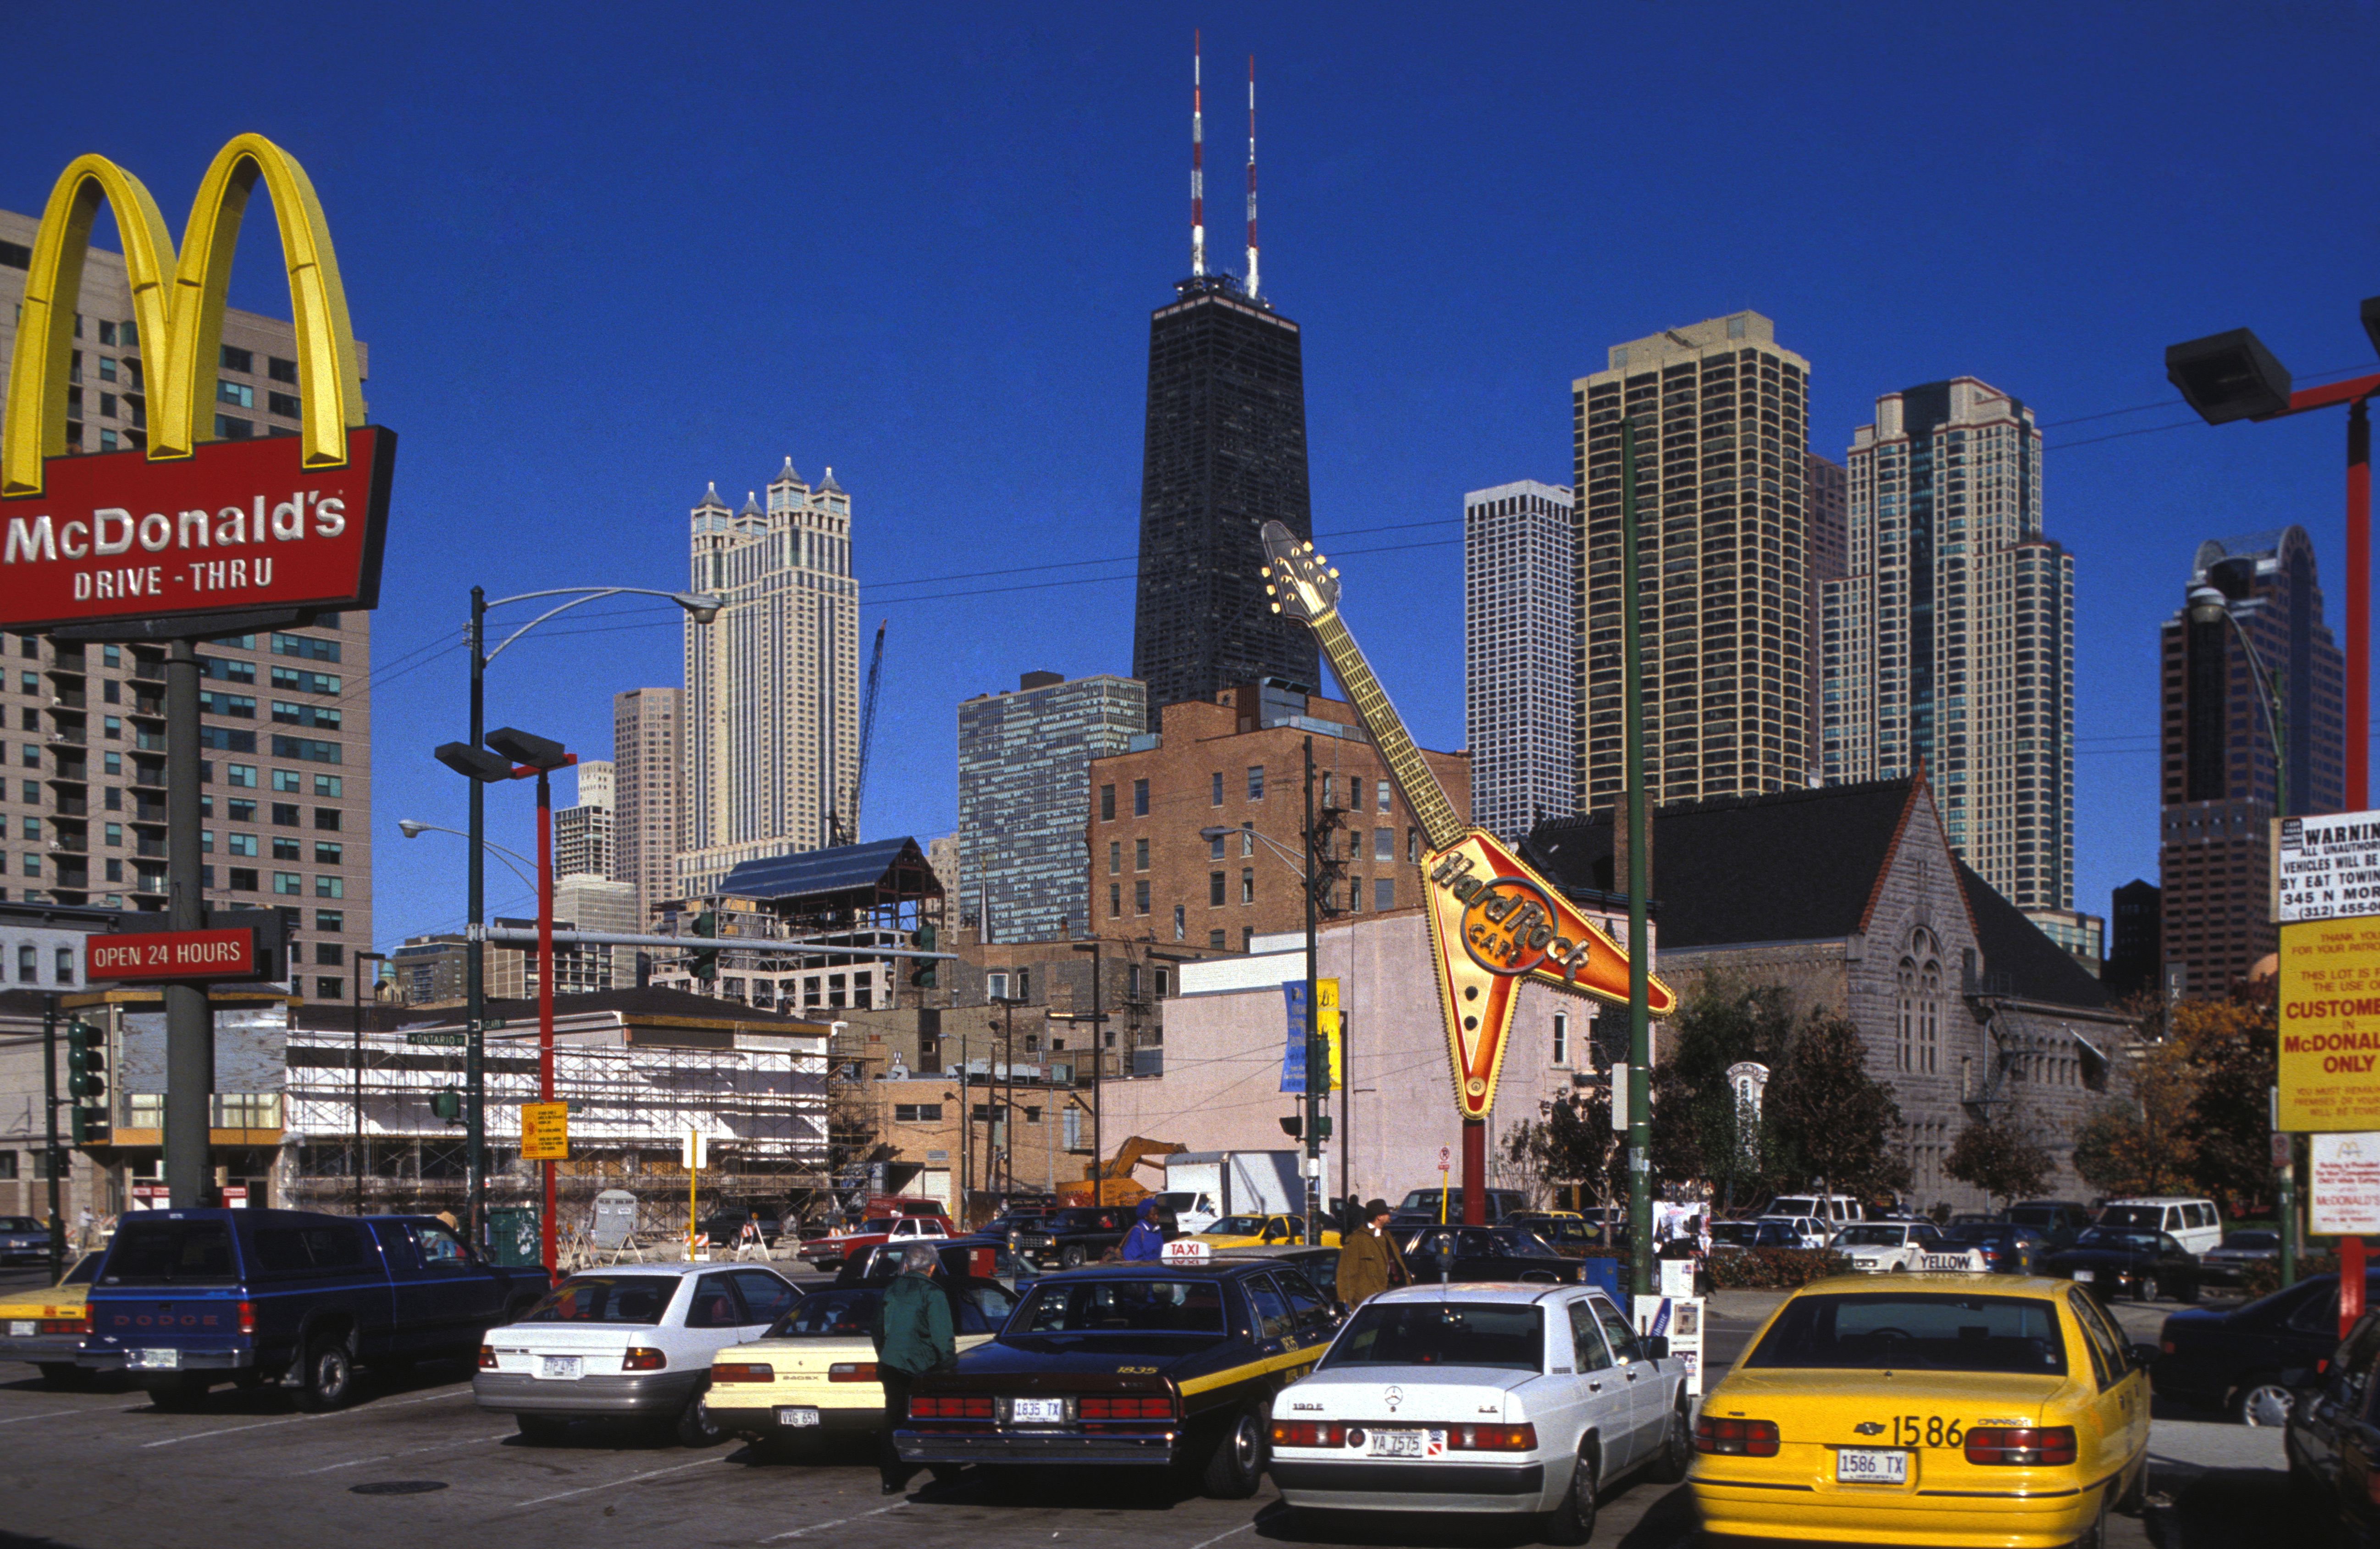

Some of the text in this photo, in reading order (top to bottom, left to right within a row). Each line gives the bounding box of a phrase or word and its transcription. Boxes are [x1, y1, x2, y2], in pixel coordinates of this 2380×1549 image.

[4, 489, 346, 564] McDonald's
[2301, 847, 2318, 857] ALL
[2284, 853, 2378, 873] VEHICLES WILL BE
[2280, 878, 2297, 890] BY
[2305, 874, 2330, 888] E&T
[2284, 891, 2314, 905] 345
[2323, 890, 2334, 902] N
[1430, 850, 1590, 981] Hard Rock
[2299, 905, 2335, 918] (312)
[2320, 932, 2353, 942] THANK
[95, 941, 241, 968] OPEN 24 HOURS
[2292, 946, 2312, 955] FOR
[2318, 944, 2344, 954] YOUR
[2301, 970, 2325, 980] THIS
[2330, 968, 2353, 979] LOT
[2358, 967, 2370, 978] IS
[2314, 982, 2335, 992] THE
[2340, 980, 2363, 991] USE
[2342, 1019, 2355, 1030] IN
[417, 1035, 455, 1045] ONTARIO
[2323, 1055, 2376, 1073] ONLY
[1171, 1243, 1200, 1256] TAXI
[1921, 1255, 1970, 1269] YELLOW
[114, 1315, 219, 1326] DODGE
[1117, 1366, 1159, 1374] 1835
[1016, 1402, 1059, 1416] 1835 TX
[782, 1412, 818, 1424] VXG 651
[1893, 1416, 1963, 1447] 1586
[1373, 1436, 1419, 1450] YA 7575
[1841, 1455, 1903, 1473] 1586 TX
